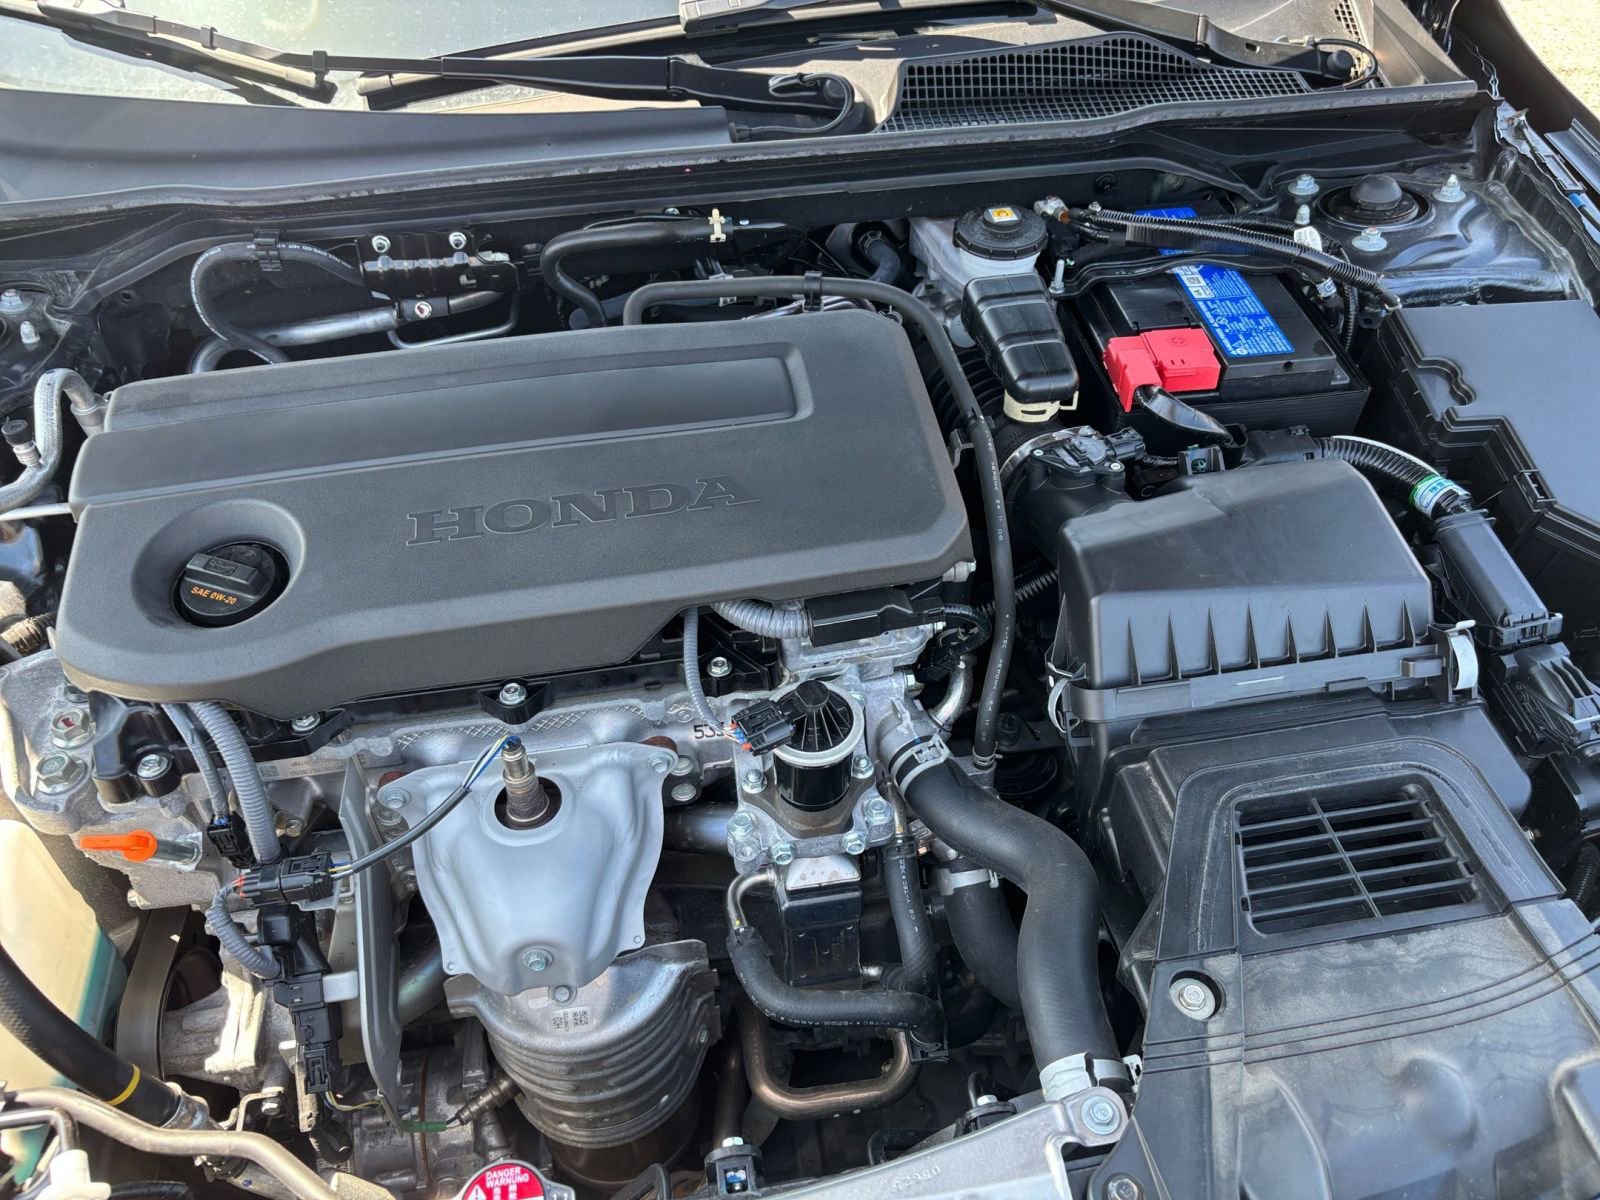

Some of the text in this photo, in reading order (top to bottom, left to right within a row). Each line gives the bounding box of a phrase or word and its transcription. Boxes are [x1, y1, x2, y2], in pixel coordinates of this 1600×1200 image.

[405, 474, 762, 547] HONDA
[191, 586, 237, 605] SAE 0W-20
[485, 1166, 522, 1181] DANGER
[485, 1173, 530, 1189] WARNUNG
